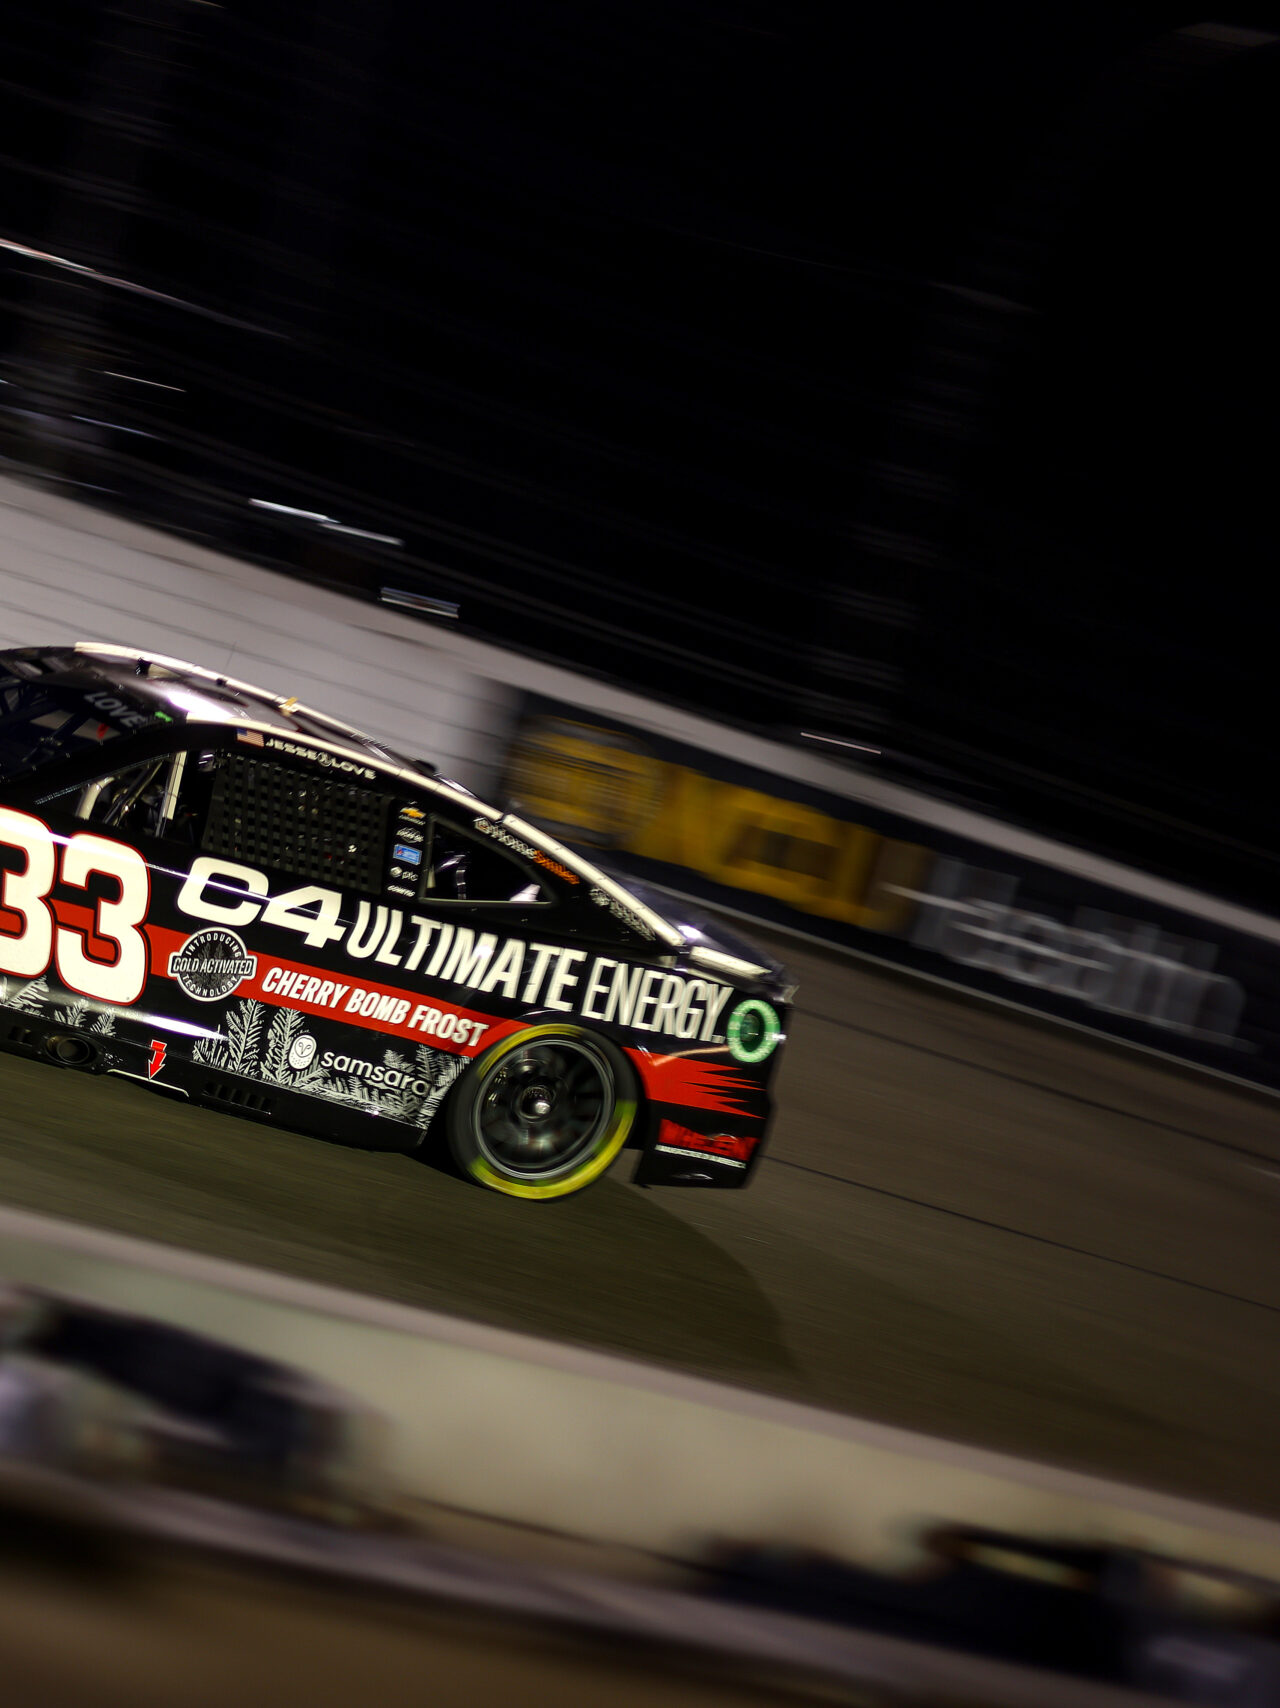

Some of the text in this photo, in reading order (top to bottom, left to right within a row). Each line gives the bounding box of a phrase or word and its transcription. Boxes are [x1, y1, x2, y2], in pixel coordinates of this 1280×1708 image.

[83, 691, 145, 728] LOVE
[266, 738, 377, 780] JESSE LOVE
[177, 856, 348, 949] C4
[345, 900, 588, 1012] ULTIMATE
[185, 932, 242, 958] INTRODUCING
[173, 957, 253, 975] COLD ACTIVATED
[182, 973, 238, 997] TECHNOLOGY
[261, 966, 490, 1047] CHERRY BOMB FROST
[320, 1050, 432, 1097] samsara
